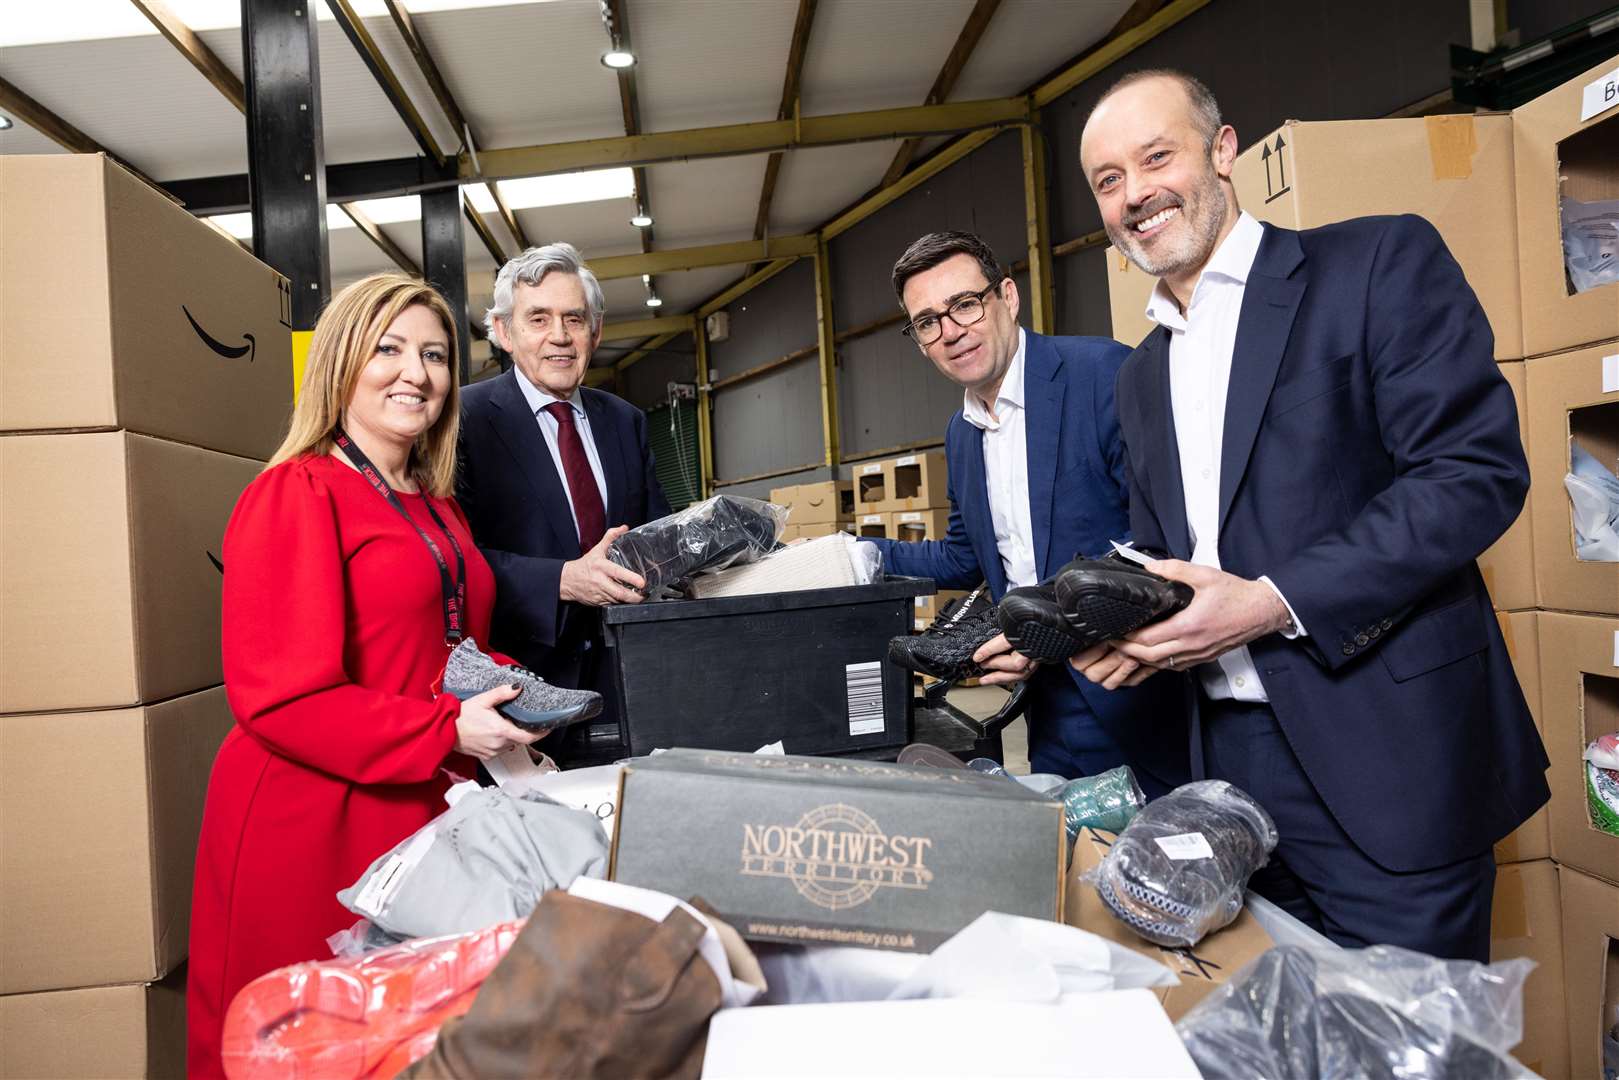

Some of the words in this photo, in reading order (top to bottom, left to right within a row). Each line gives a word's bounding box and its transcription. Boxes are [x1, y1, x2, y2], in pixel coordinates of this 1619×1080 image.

[1604, 80, 1619, 102] B
[741, 823, 932, 868] NORTHWEST
[742, 858, 926, 886] TERRITORY
